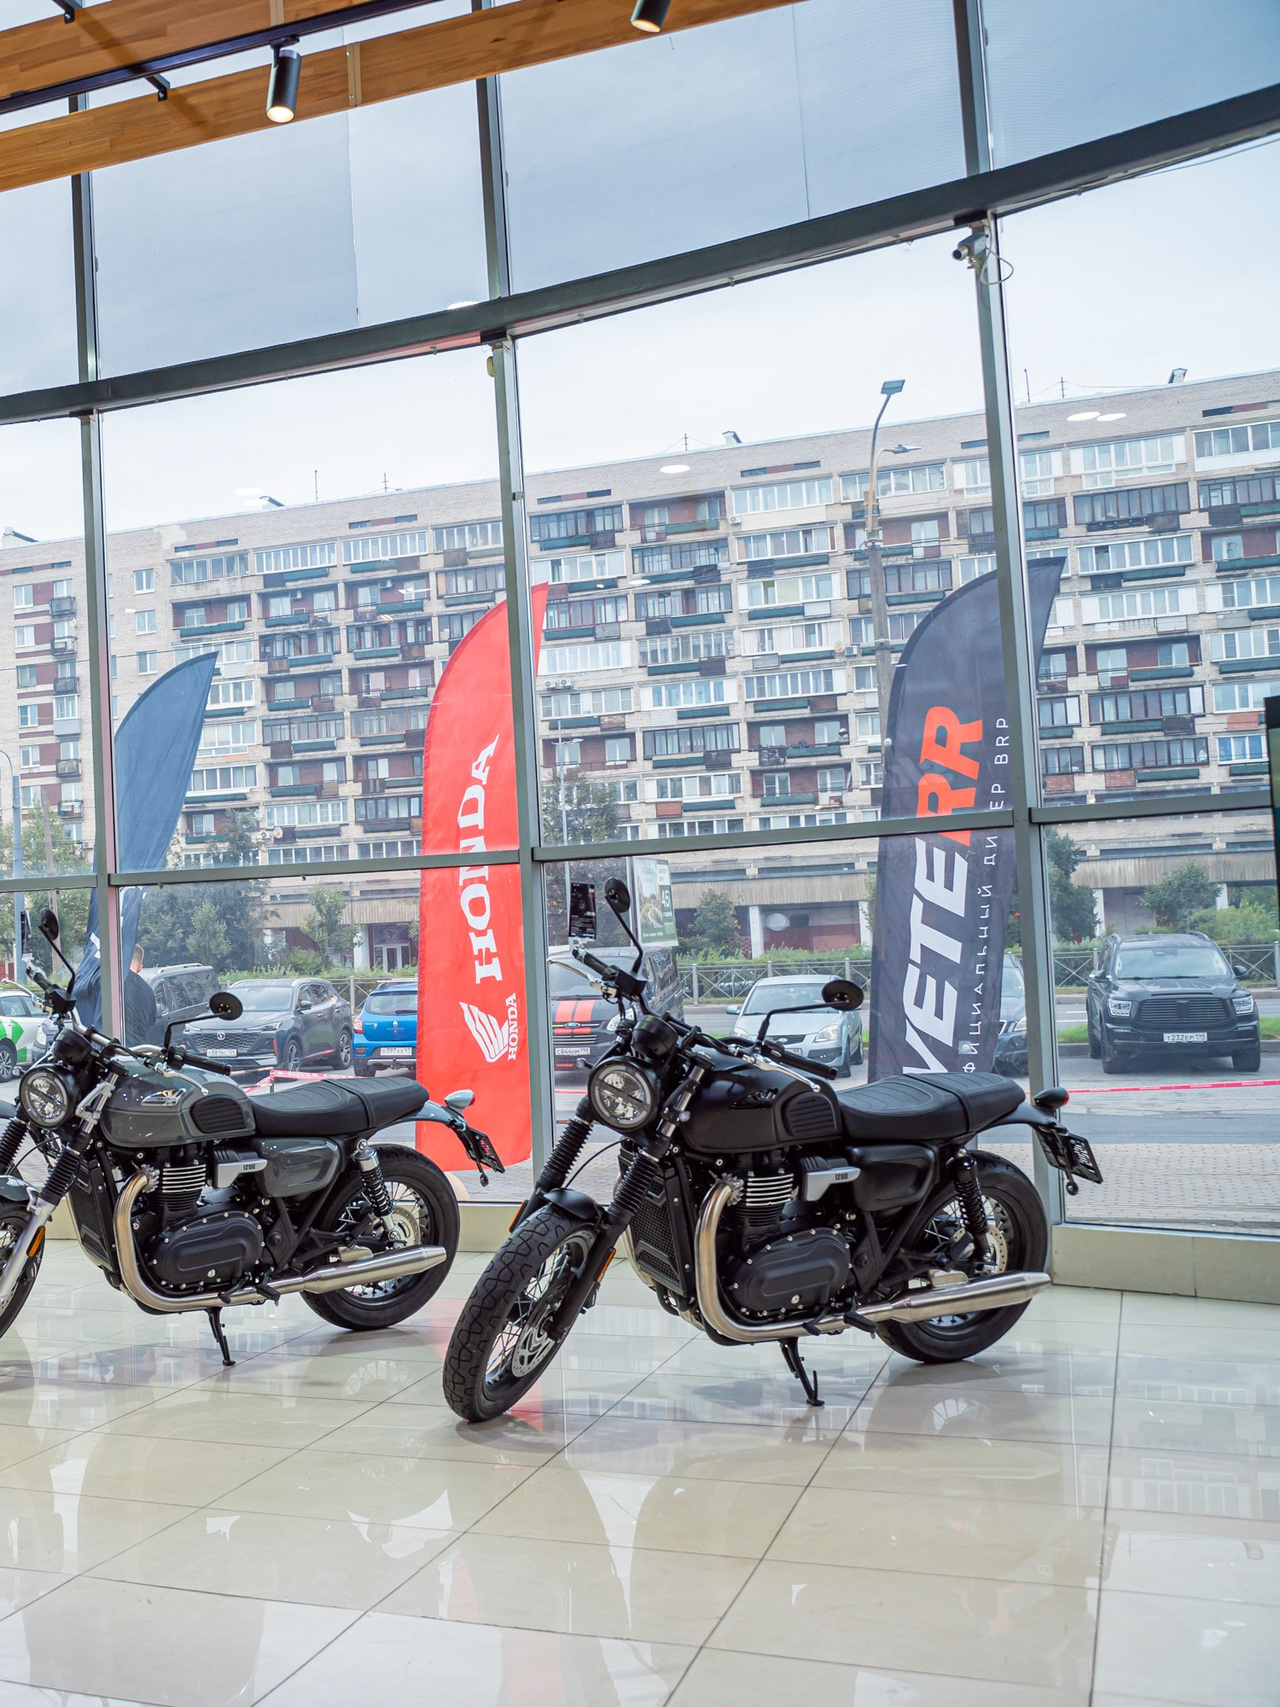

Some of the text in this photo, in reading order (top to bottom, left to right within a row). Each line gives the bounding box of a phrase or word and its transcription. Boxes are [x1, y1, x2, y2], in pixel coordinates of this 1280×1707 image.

[457, 734, 503, 984] HONDA
[963, 717, 1010, 1074] ФИЦИАЛЬНЫЙ ДИЕР BRP
[505, 992, 519, 1061] HONDA
